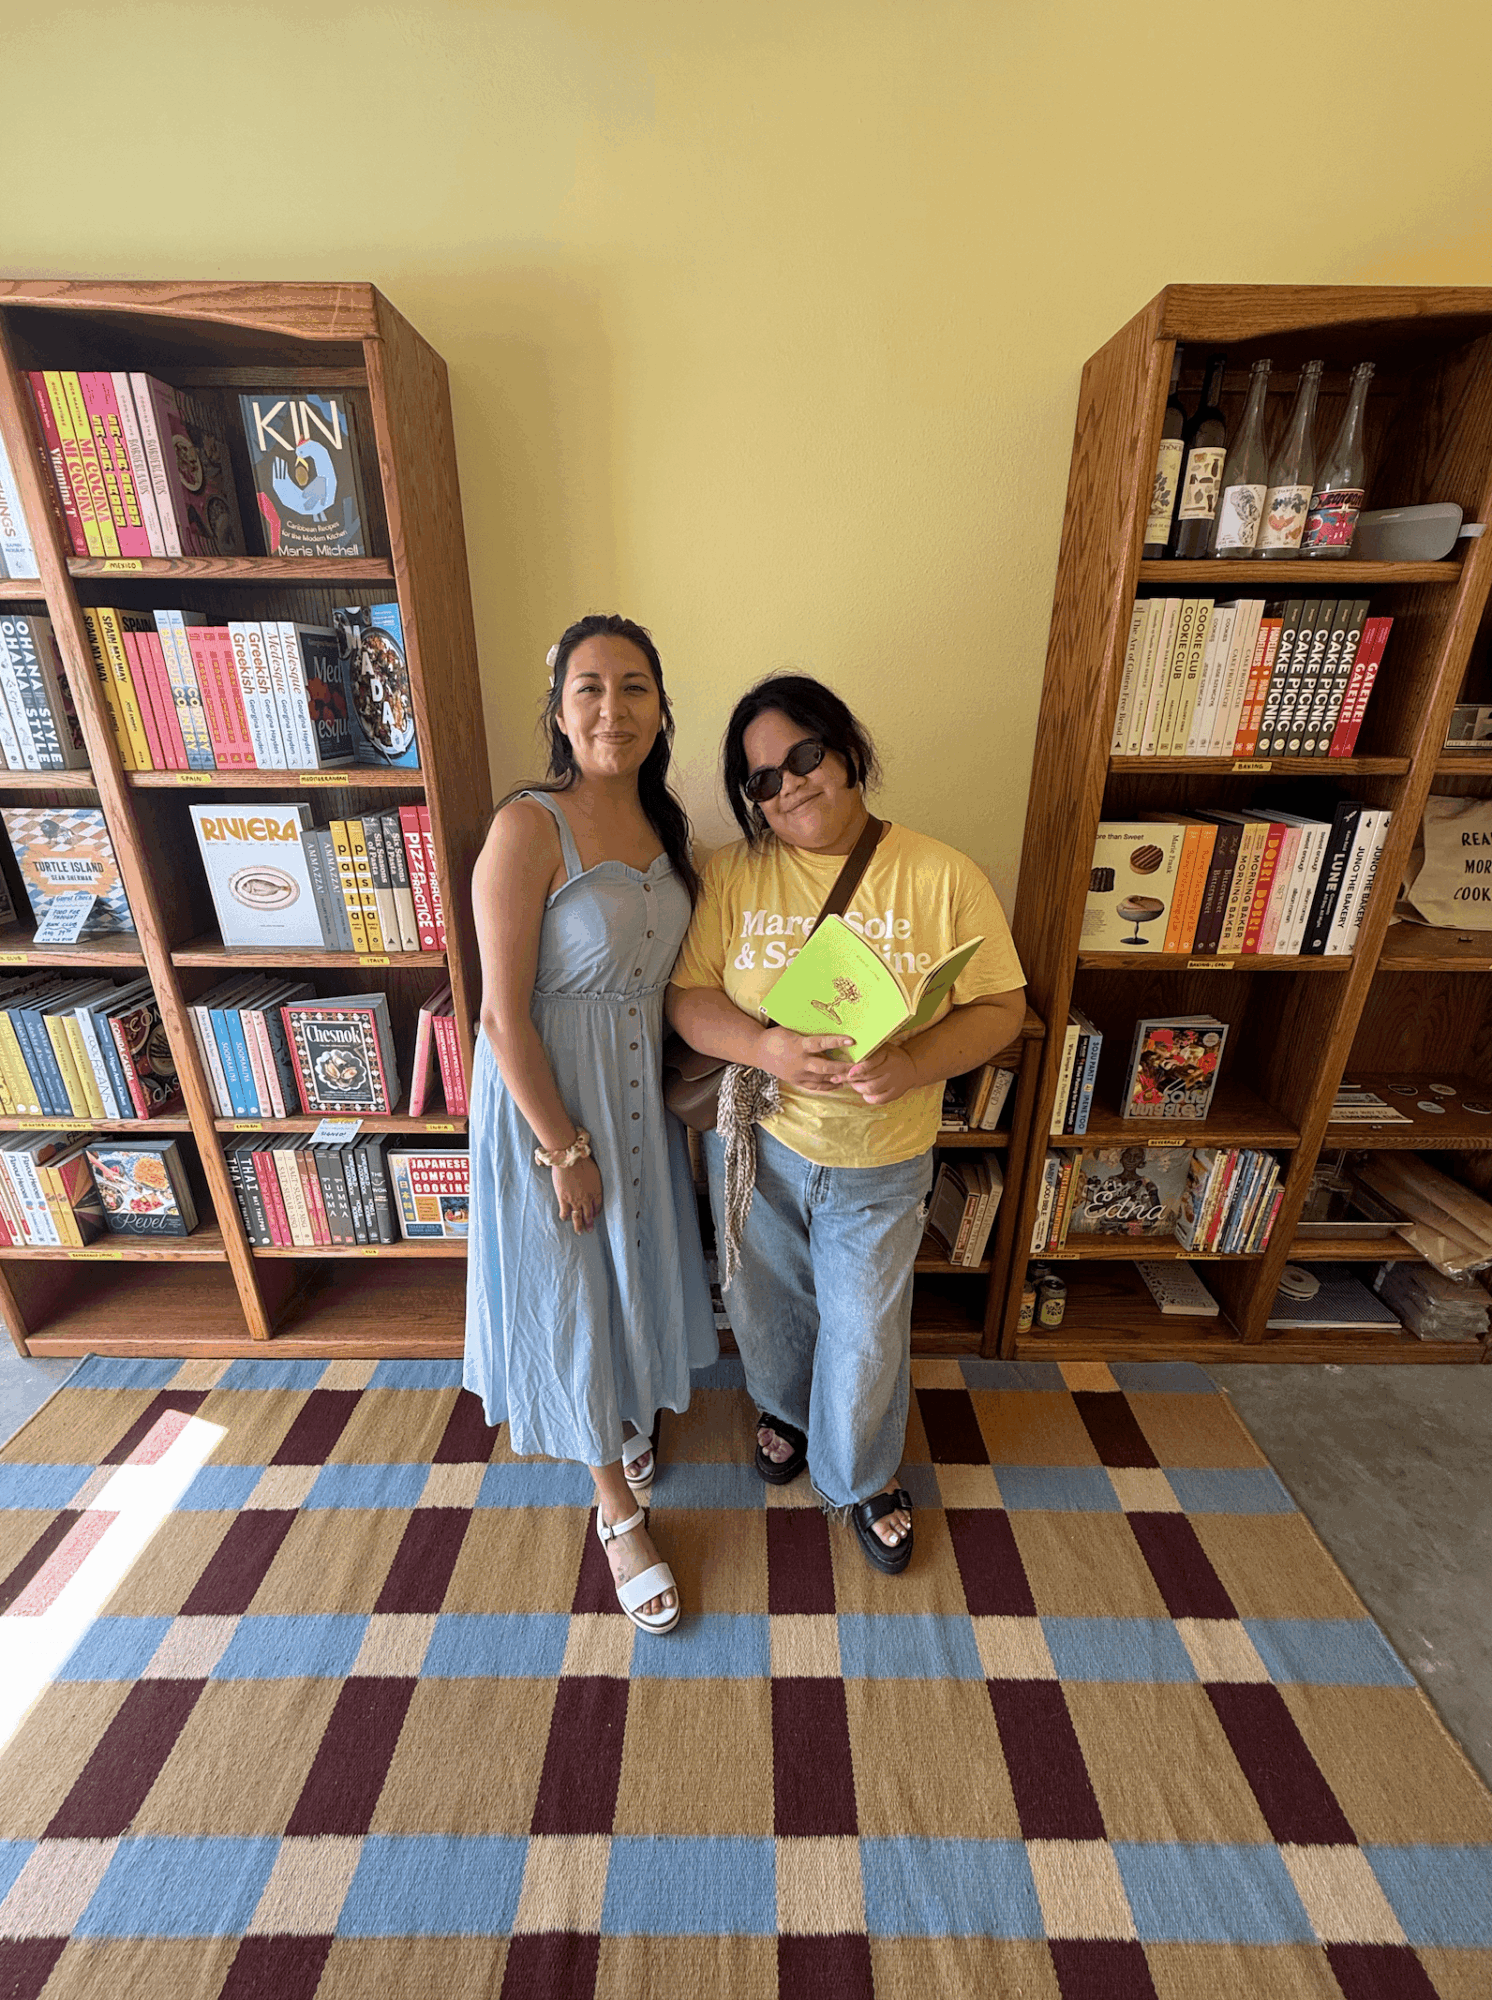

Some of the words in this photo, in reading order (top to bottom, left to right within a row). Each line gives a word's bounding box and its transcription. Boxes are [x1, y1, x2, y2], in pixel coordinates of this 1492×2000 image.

[252, 400, 342, 452] KIN
[62, 439, 78, 458] MI
[80, 439, 95, 458] MI
[50, 447, 72, 506] Vitamina
[65, 508, 78, 518] T
[128, 438, 150, 496] BORDERLANDS
[145, 438, 168, 496] BORDERLANDS
[68, 462, 94, 522] COCINA
[85, 462, 110, 522] COCINA
[281, 529, 290, 538] for
[292, 532, 302, 540] the
[303, 533, 326, 542] Modern
[326, 530, 348, 541] Kitchen
[286, 520, 318, 534] Caribbean
[318, 521, 340, 532] Recipes
[278, 545, 314, 557] Marie
[317, 544, 359, 557] Mitchell
[84, 616, 97, 646] SPAIN
[102, 616, 116, 646] SPAIN
[122, 616, 152, 632] SPAIN
[1132, 619, 1140, 636] The
[1179, 606, 1194, 650] COOKIE
[1193, 606, 1208, 650] COOKIE
[92, 646, 102, 661] MY
[114, 646, 122, 661] MY
[1128, 654, 1134, 663] of
[1130, 638, 1138, 654] Art
[1274, 629, 1296, 674] CAKE
[1290, 629, 1312, 674] CAKE
[1306, 629, 1328, 674] CAKE
[1322, 629, 1345, 674] CAKE
[1338, 629, 1360, 674] CAKE
[96, 663, 109, 684] WAY
[115, 662, 127, 684] WAY
[1122, 664, 1134, 690] Gluten
[1172, 652, 1186, 680] CLUB
[1187, 651, 1200, 680] CLUB
[2, 621, 31, 691] OHANA
[26, 708, 51, 763] STYLE
[16, 620, 44, 691] OHANA
[40, 708, 64, 762] STYLE
[160, 628, 182, 686] BASQUE
[173, 687, 198, 751] COUNTRY
[175, 628, 194, 686] BASQUE
[187, 687, 210, 752] COUNTRY
[232, 632, 256, 695] Greekish
[249, 700, 261, 729] Georgina
[255, 730, 264, 755] Hayden
[248, 632, 269, 695] Greekish
[264, 699, 274, 728] Georgina
[270, 730, 280, 755] Hayden
[266, 632, 286, 695] Medesque
[281, 699, 290, 729] Georgina
[286, 730, 296, 755] Hayden
[283, 632, 302, 695] Medesque
[297, 699, 307, 728] Georgina
[302, 730, 312, 755] Hayden
[1120, 692, 1129, 711] Free
[1262, 678, 1284, 732] PICNIC
[1276, 678, 1300, 732] PICNIC
[1292, 678, 1317, 732] PICNIC
[1308, 678, 1333, 732] PICNIC
[1322, 678, 1348, 732] PICNIC
[1340, 662, 1366, 724] GALETTE!
[1352, 662, 1378, 723] GALETTE!
[1116, 711, 1126, 736] Bread
[200, 818, 299, 841] RIVIERA
[368, 841, 374, 850] of
[374, 832, 382, 846] Six
[386, 840, 392, 850] of
[392, 832, 400, 846] Six
[1169, 834, 1180, 856] Marie
[1462, 832, 1492, 846] REA
[32, 861, 69, 873] TURTLE
[72, 862, 104, 873] ISLAND
[307, 842, 324, 894] AMMAZZA!
[324, 842, 340, 894] AMMAZZA!
[370, 851, 379, 876] Pasta
[376, 848, 388, 883] Seasons
[388, 850, 396, 875] Pasta
[394, 847, 406, 882] Seasons
[404, 832, 426, 884] PIZZA
[1166, 857, 1176, 874] Frank
[1326, 854, 1346, 892] LUNE
[1352, 846, 1365, 872] JUNO
[1369, 846, 1382, 872] JUNO
[338, 844, 360, 920] pasta
[355, 844, 376, 920] pasta
[1204, 869, 1220, 914] Bittersweet
[1216, 868, 1232, 914] Bittersweet
[1231, 855, 1247, 904] MORNING
[1244, 854, 1260, 904] MORNING
[1347, 874, 1358, 892] THE
[1364, 874, 1376, 892] THE
[1454, 886, 1492, 901] COOK
[411, 872, 434, 928] PRACTICE
[1337, 893, 1353, 928] BAKERY
[1354, 893, 1370, 928] BAKERY
[740, 909, 818, 938] Mare
[843, 910, 911, 940] Sole
[1224, 906, 1236, 938] BAKER
[1236, 906, 1248, 938] BAKER
[734, 942, 756, 970] &
[763, 941, 932, 974] Saine
[88, 1035, 100, 1058] COOL
[306, 1024, 362, 1043] Chesnok
[111, 1022, 125, 1053] COMIDA
[120, 1053, 134, 1081] CASERA
[222, 1042, 236, 1082] SOOMAALIYA
[236, 1042, 250, 1082] SOOMAALIYA
[1090, 1042, 1100, 1060] SOJU
[90, 1058, 113, 1103] BEANS
[1087, 1061, 1096, 1082] PARTY
[1081, 1094, 1090, 1114] IRENE
[1078, 1115, 1086, 1130] YOO
[9, 1155, 21, 1178] Flavour
[16, 1178, 28, 1200] Heroes
[21, 1155, 34, 1178] Flavour
[30, 1178, 40, 1200] Heroes
[411, 1159, 468, 1169] JAPANESE
[412, 1172, 469, 1181] COMFORT
[240, 1158, 259, 1191] THAI
[252, 1196, 260, 1206] NAT
[256, 1208, 266, 1232] THAIPUN
[1084, 1190, 1168, 1220] Edna
[111, 1208, 168, 1234] Revel
